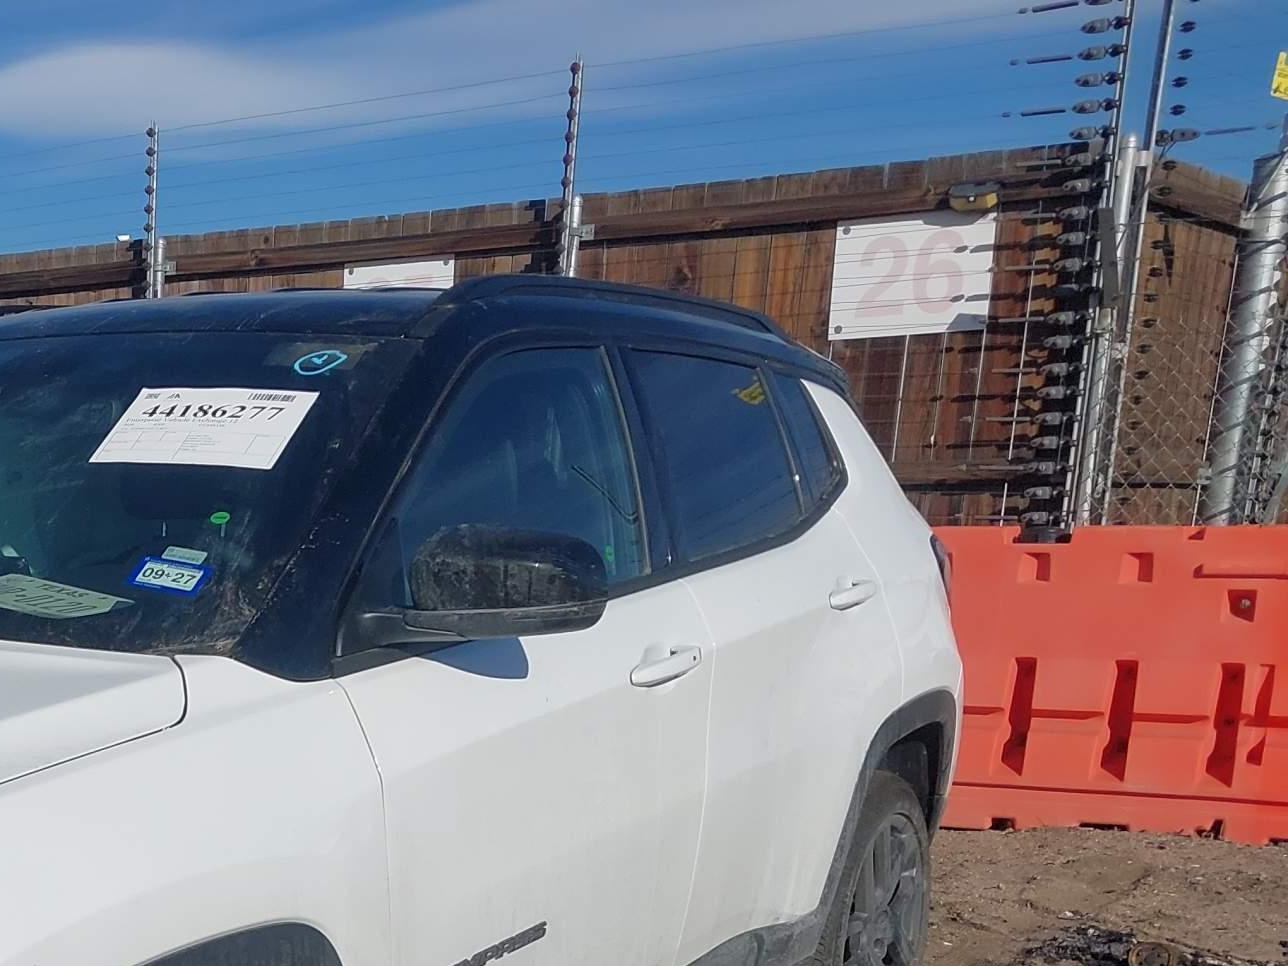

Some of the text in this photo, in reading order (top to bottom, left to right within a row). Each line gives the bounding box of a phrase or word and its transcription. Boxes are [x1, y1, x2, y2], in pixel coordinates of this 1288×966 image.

[856, 230, 965, 317] 26
[142, 403, 285, 421] 44186277
[36, 583, 90, 598] TEXAS
